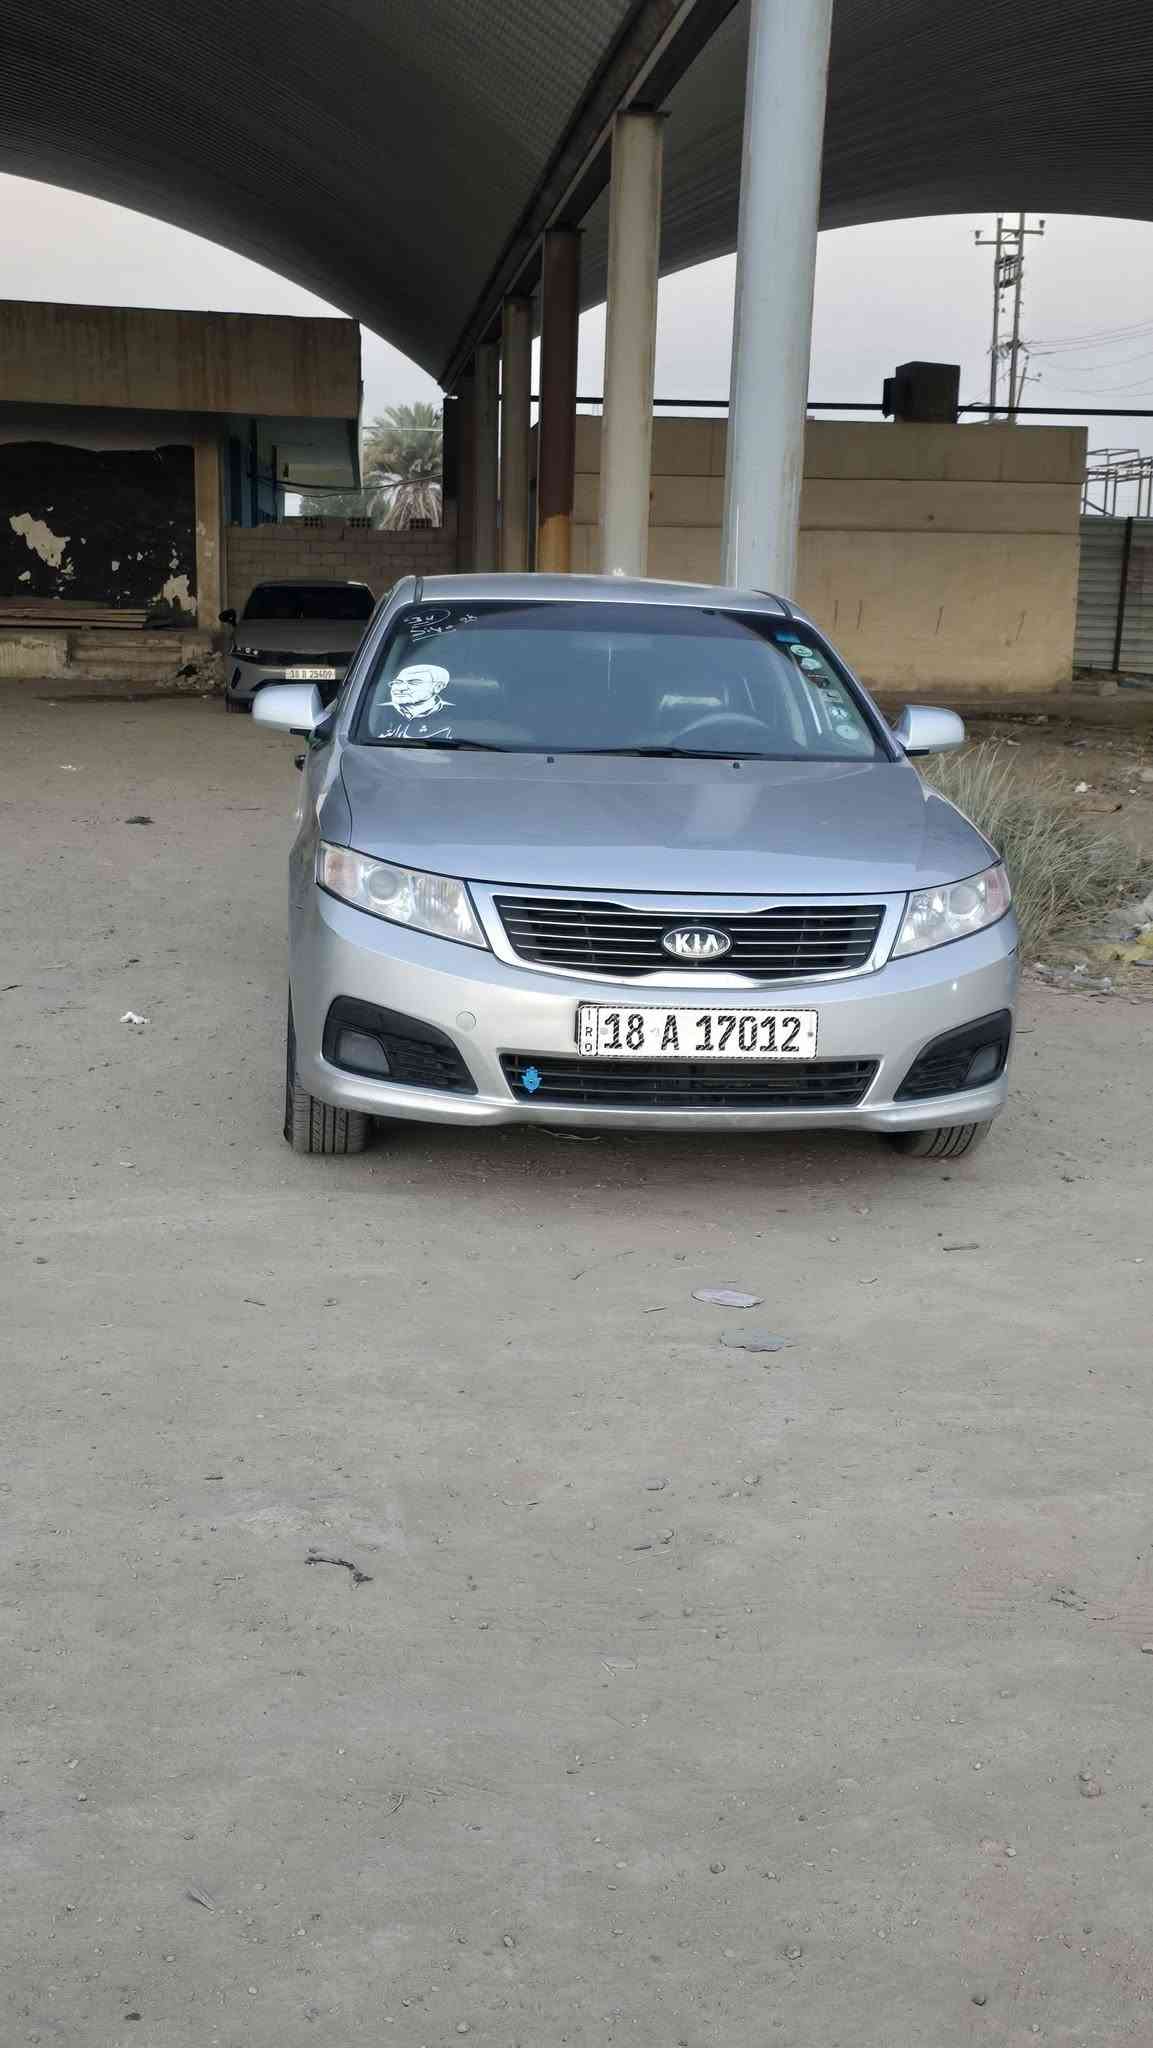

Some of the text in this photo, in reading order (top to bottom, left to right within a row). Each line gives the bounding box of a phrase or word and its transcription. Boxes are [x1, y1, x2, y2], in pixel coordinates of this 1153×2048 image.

[675, 933, 719, 953] KIA
[604, 1013, 801, 1052] 18 A 17012
